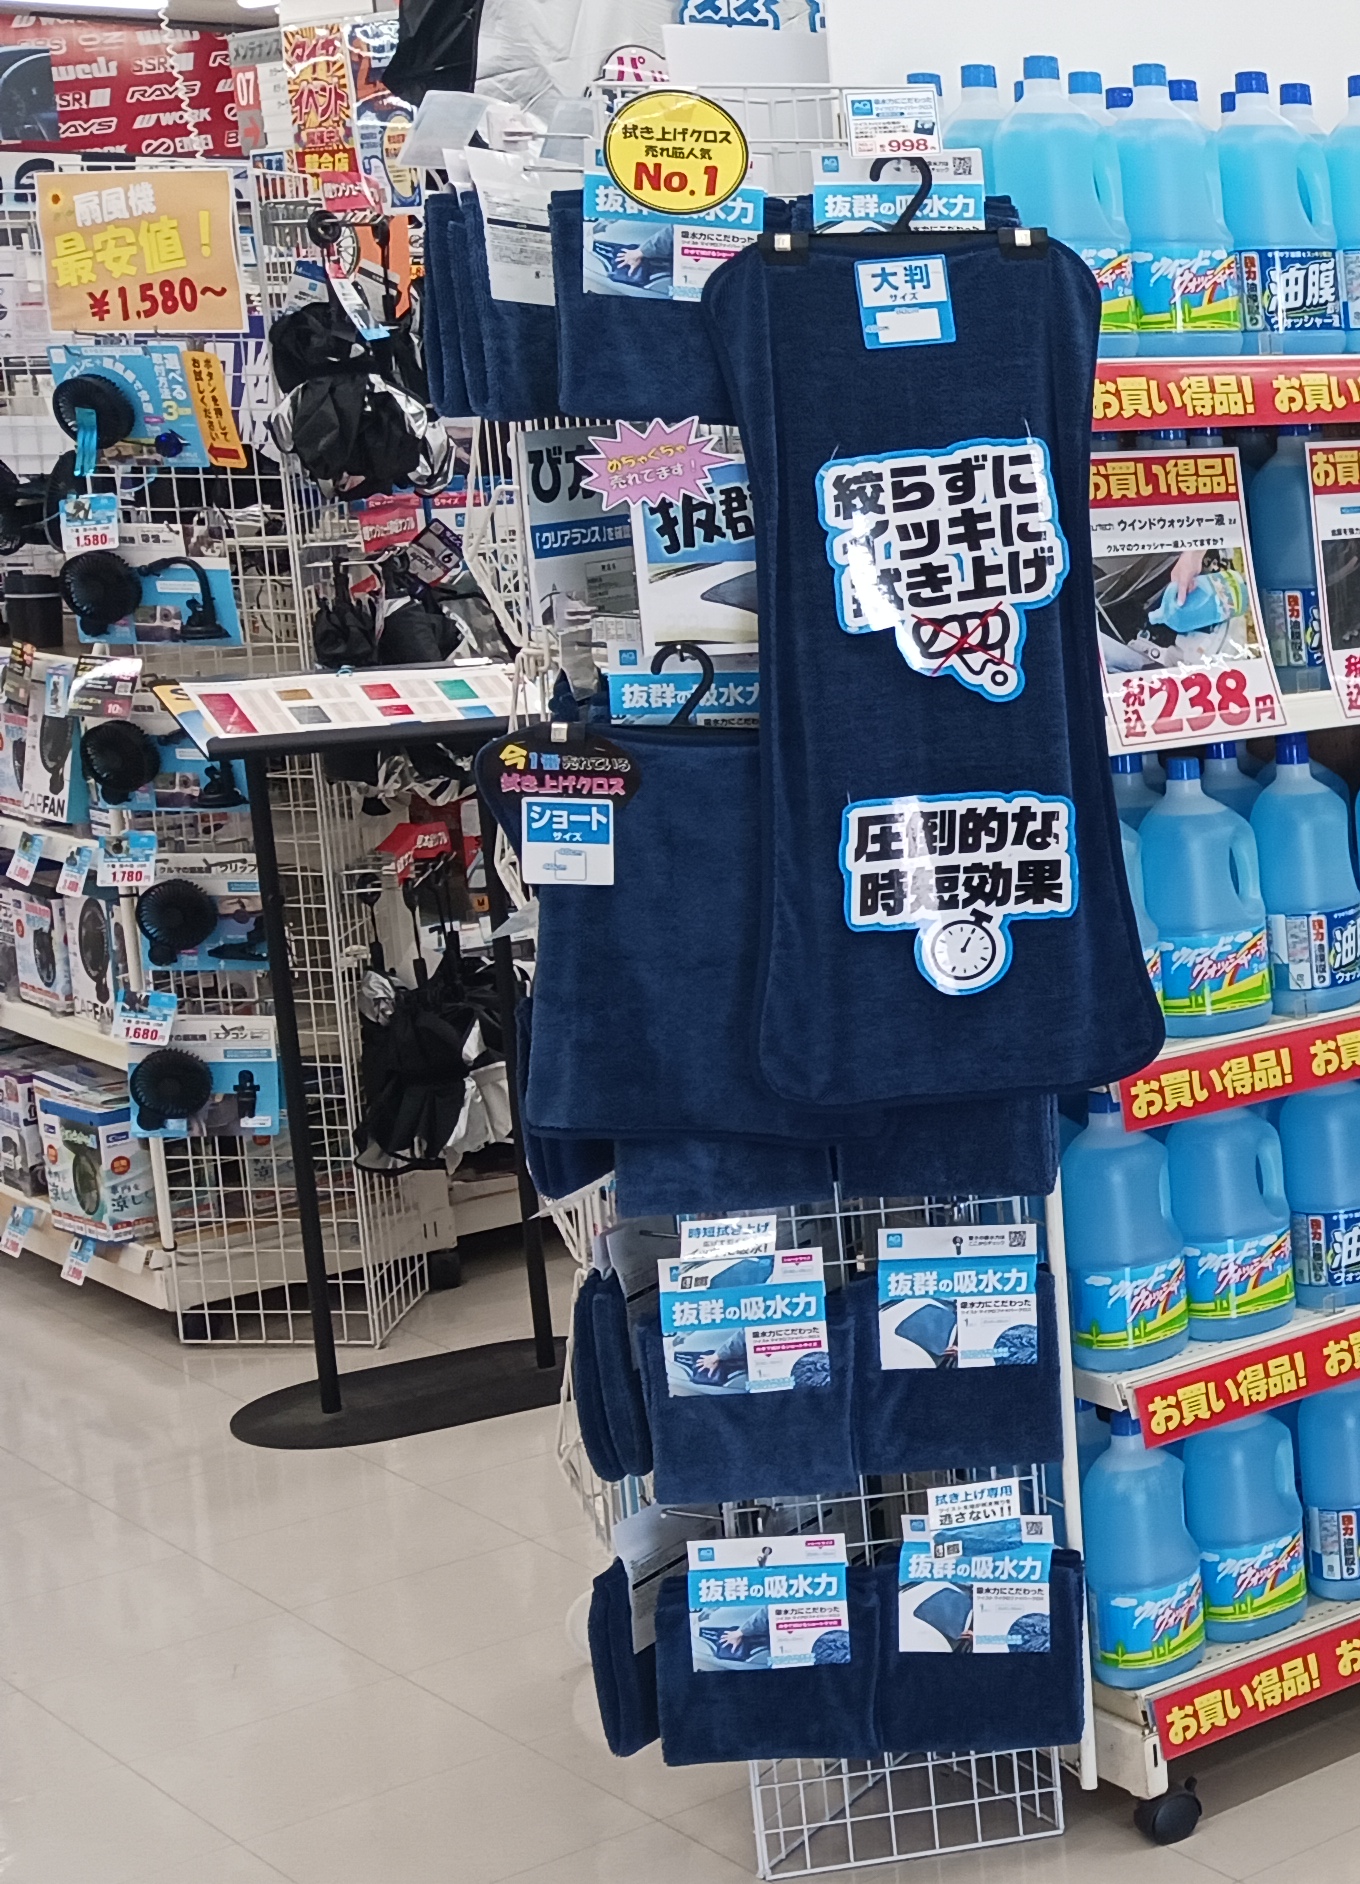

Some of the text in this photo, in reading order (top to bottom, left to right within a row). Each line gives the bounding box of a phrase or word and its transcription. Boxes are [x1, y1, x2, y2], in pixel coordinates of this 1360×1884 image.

[235, 71, 256, 107] 07
[621, 124, 733, 145] 拭き上げクロス
[643, 144, 714, 162] 売れ筋人気
[633, 161, 719, 197] No.1
[73, 182, 157, 227] 扇風機
[869, 264, 932, 292] 大判
[1266, 260, 1337, 314] 油膜
[888, 291, 919, 303] サイズ
[607, 442, 686, 472] めちゃくちゃ
[832, 454, 1035, 519] 絞らずに
[1117, 514, 1226, 532] ウインドウォッシャー液
[501, 774, 625, 796] 拭き上げクロス
[528, 806, 607, 829] ショート
[552, 830, 582, 842] サイズ
[856, 807, 1059, 862] 圧倒的な
[860, 859, 1064, 916] 時短効果
[888, 1268, 1027, 1297] 抜群の吸水力
[672, 1293, 817, 1327] 抜群の吸水力
[935, 1485, 1013, 1506] 拭き上げ専用
[908, 1554, 1042, 1581] 抜群の吸水力
[699, 1573, 837, 1603] 抜群の吸水力
